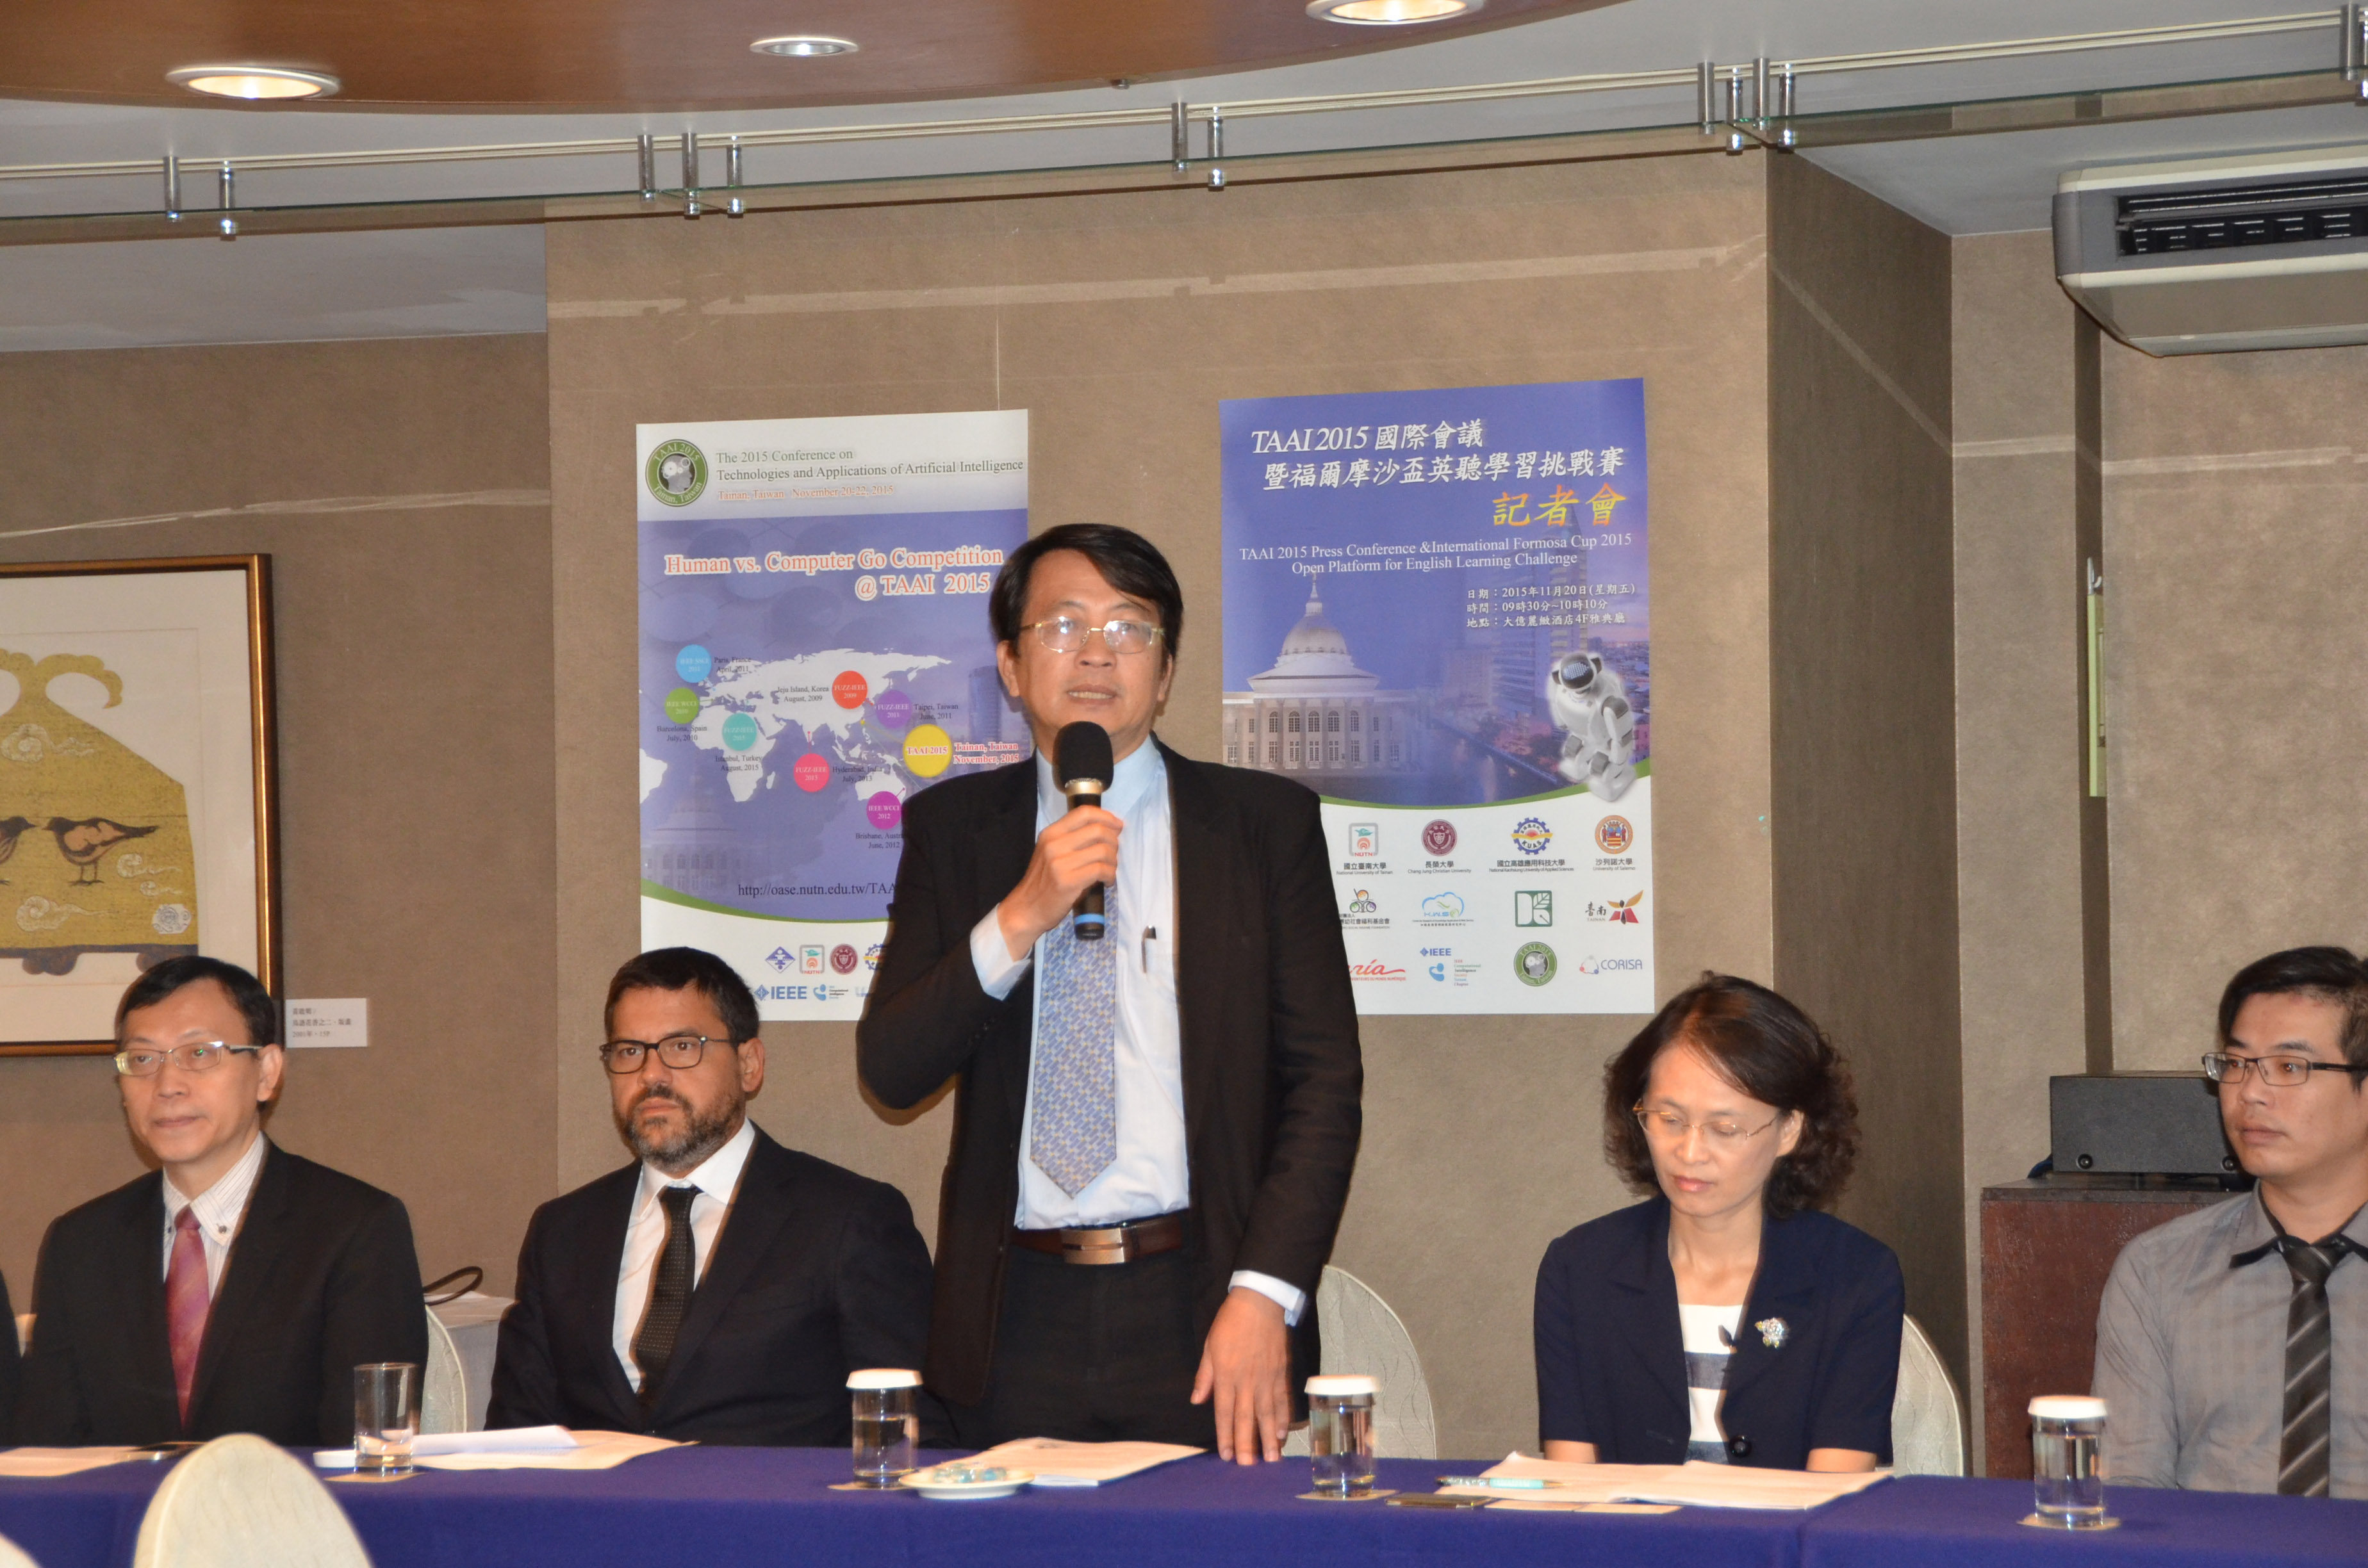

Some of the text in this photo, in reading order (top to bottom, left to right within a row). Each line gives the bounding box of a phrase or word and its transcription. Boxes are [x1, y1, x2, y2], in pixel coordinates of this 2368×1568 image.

[1251, 418, 1484, 453] TAAI 2015 國際會議
[654, 443, 700, 461] TAAI 2015
[716, 450, 853, 464] The 2015 Conference on
[716, 460, 1024, 482] Technologies and Applications of Artificial Intelligence
[1263, 446, 1625, 491] 暨福爾摩沙盃英聽學習挑戰賽
[718, 490, 750, 501] Tainan,
[753, 489, 784, 500] Taiwan
[792, 486, 839, 498] November
[872, 485, 894, 495] 2015
[1492, 482, 1627, 527] 記者會
[1239, 534, 1632, 560] TAAI 2015 Press Conference &International Formosa Cup 2015
[666, 547, 1003, 573] Human vs. Computer Go Competition
[1292, 551, 1577, 577] Open Platform for English Learning Challenge
[856, 573, 990, 600] @ TAAI 2015
[954, 742, 1019, 753] Tainan, Taiwan
[953, 754, 1019, 764] November, 2015
[1595, 858, 1633, 866] 沙列諾大學
[1429, 948, 1451, 956] IEEE
[1600, 959, 1643, 970] CORISA
[771, 986, 807, 1000] IEEE
